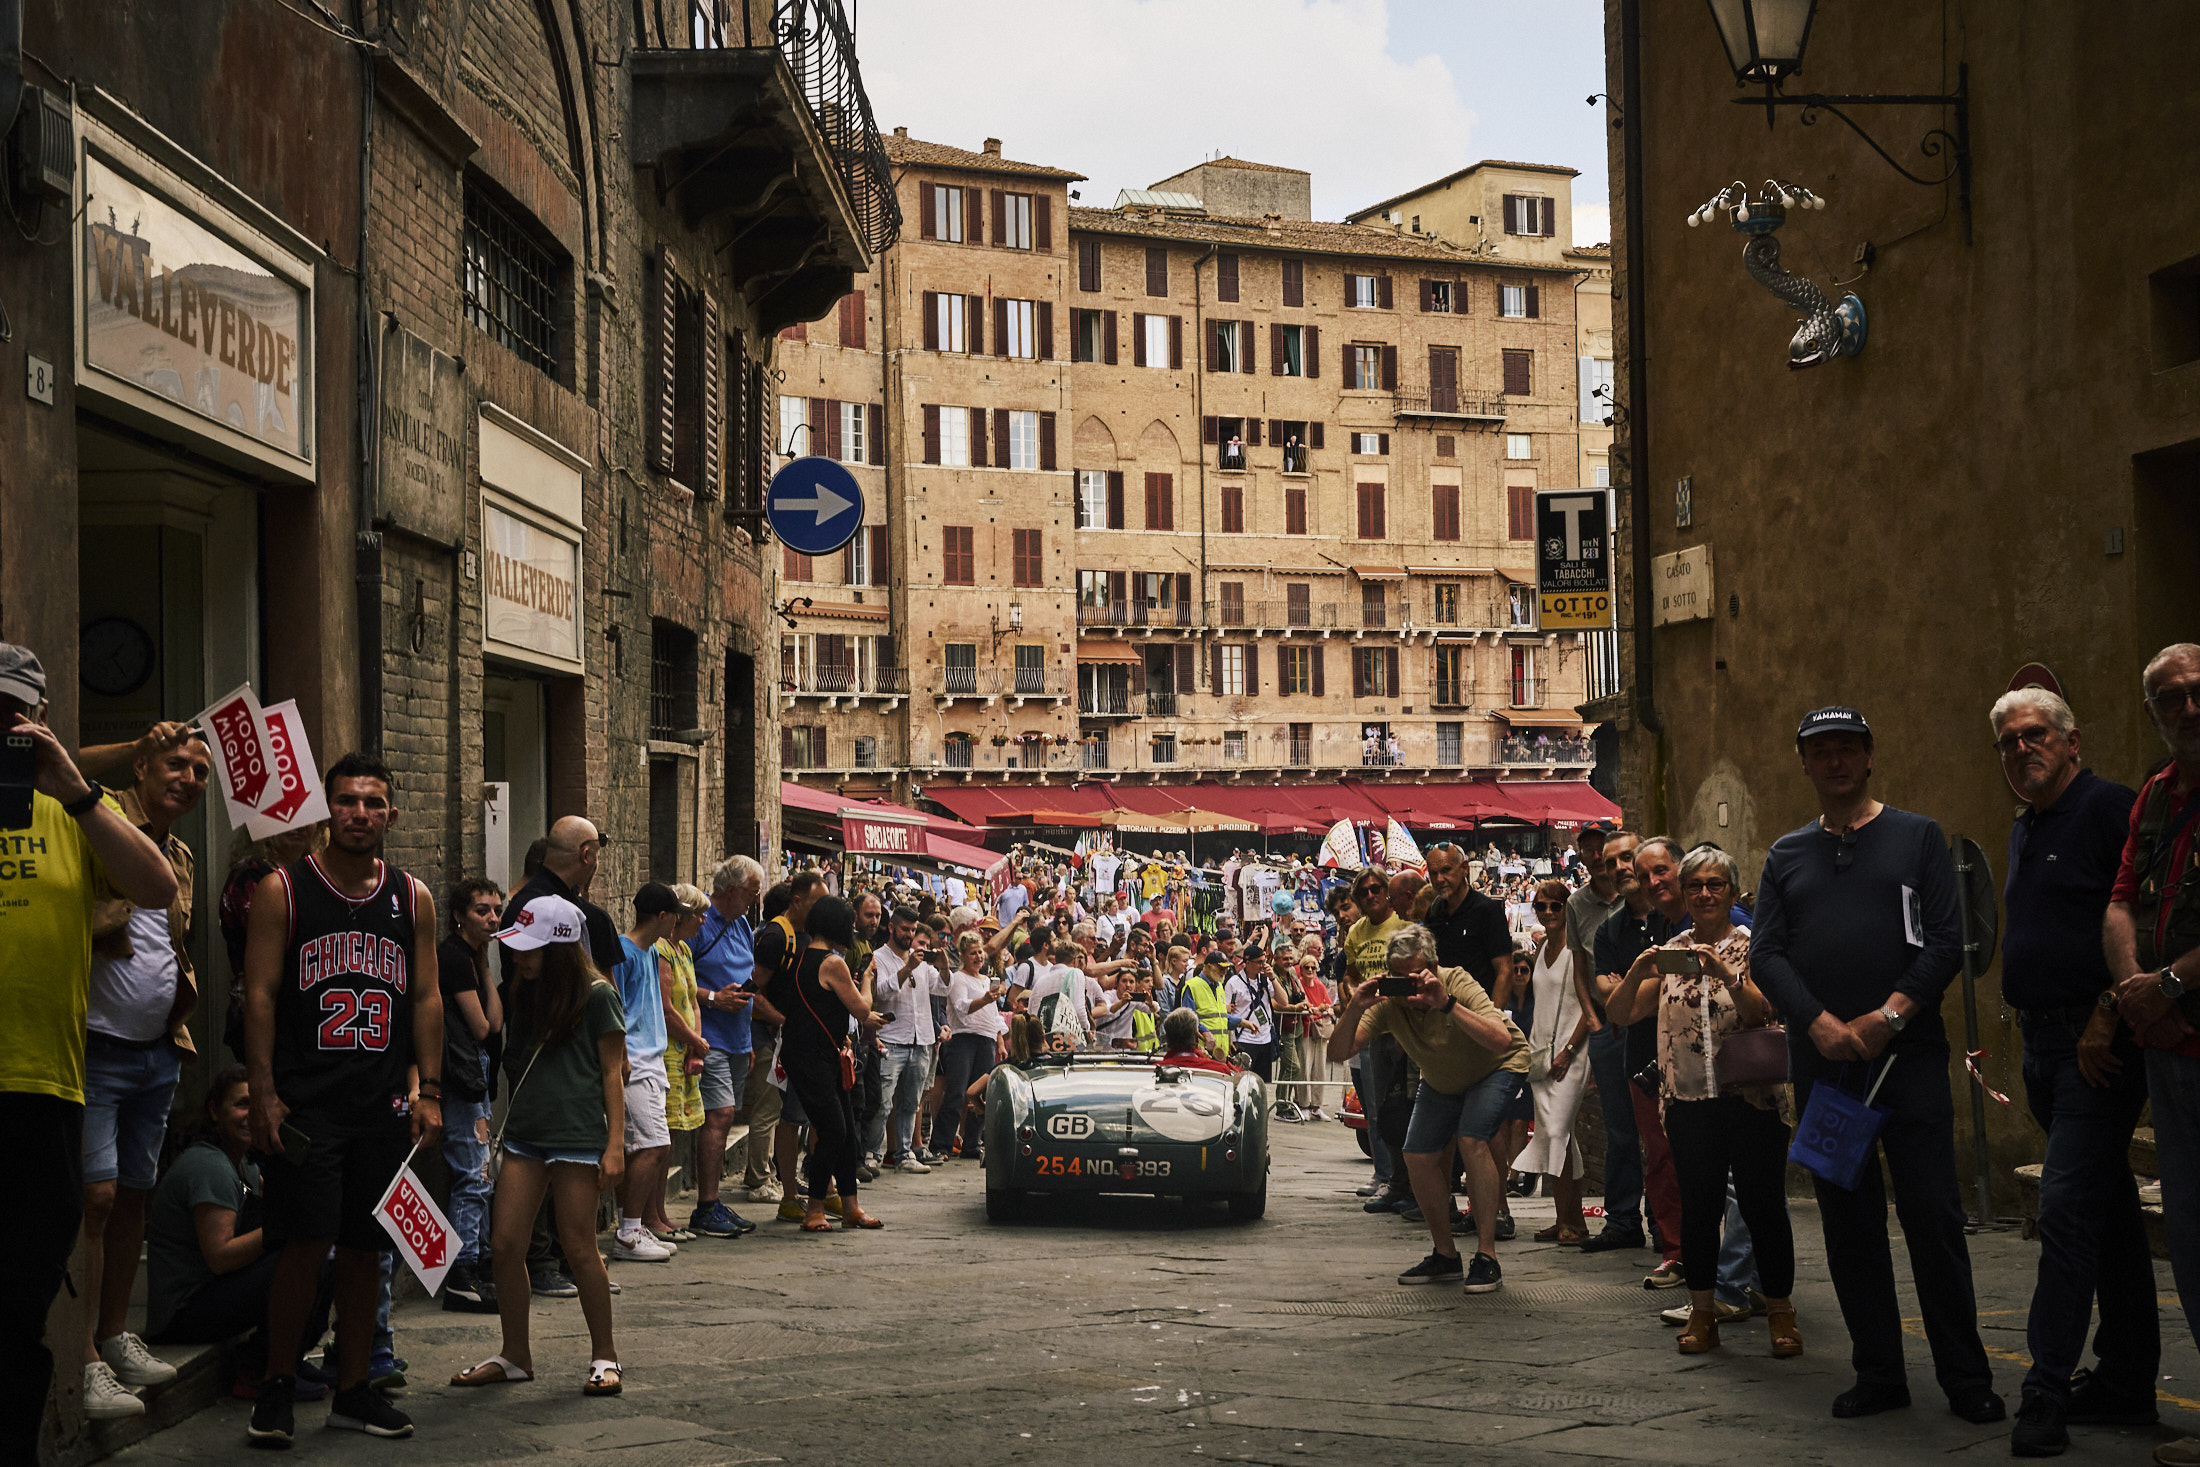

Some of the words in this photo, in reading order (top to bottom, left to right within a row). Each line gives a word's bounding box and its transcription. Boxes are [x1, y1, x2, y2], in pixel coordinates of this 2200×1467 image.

[36, 366, 45, 394] 8
[1549, 496, 1594, 561] T
[1585, 548, 1597, 558] 28
[1554, 568, 1595, 580] TABACCHI
[1666, 562, 1691, 579] CASATO
[1542, 580, 1572, 588] VALORI
[1574, 578, 1607, 587] BOLLATI
[1542, 596, 1608, 613] LOTTO
[1662, 595, 1670, 610] DI
[1673, 591, 1697, 607] SOTTO
[1582, 611, 1597, 619] 191
[234, 709, 262, 776] 1000
[215, 716, 247, 792] MIGLIA
[268, 724, 298, 792] 1000
[1116, 824, 1157, 833] RISTORANTE
[1159, 825, 1188, 834] PIZZERIA
[1292, 832, 1324, 840] TRATT
[0, 899, 29, 908] ISHED
[552, 926, 572, 939] 1927
[300, 930, 407, 995] CHICAGO
[317, 988, 393, 1052] 23
[1052, 1116, 1089, 1135] GB
[1035, 1155, 1082, 1176] 254
[400, 1182, 442, 1242] MIGLIA
[393, 1204, 429, 1255] 1000
